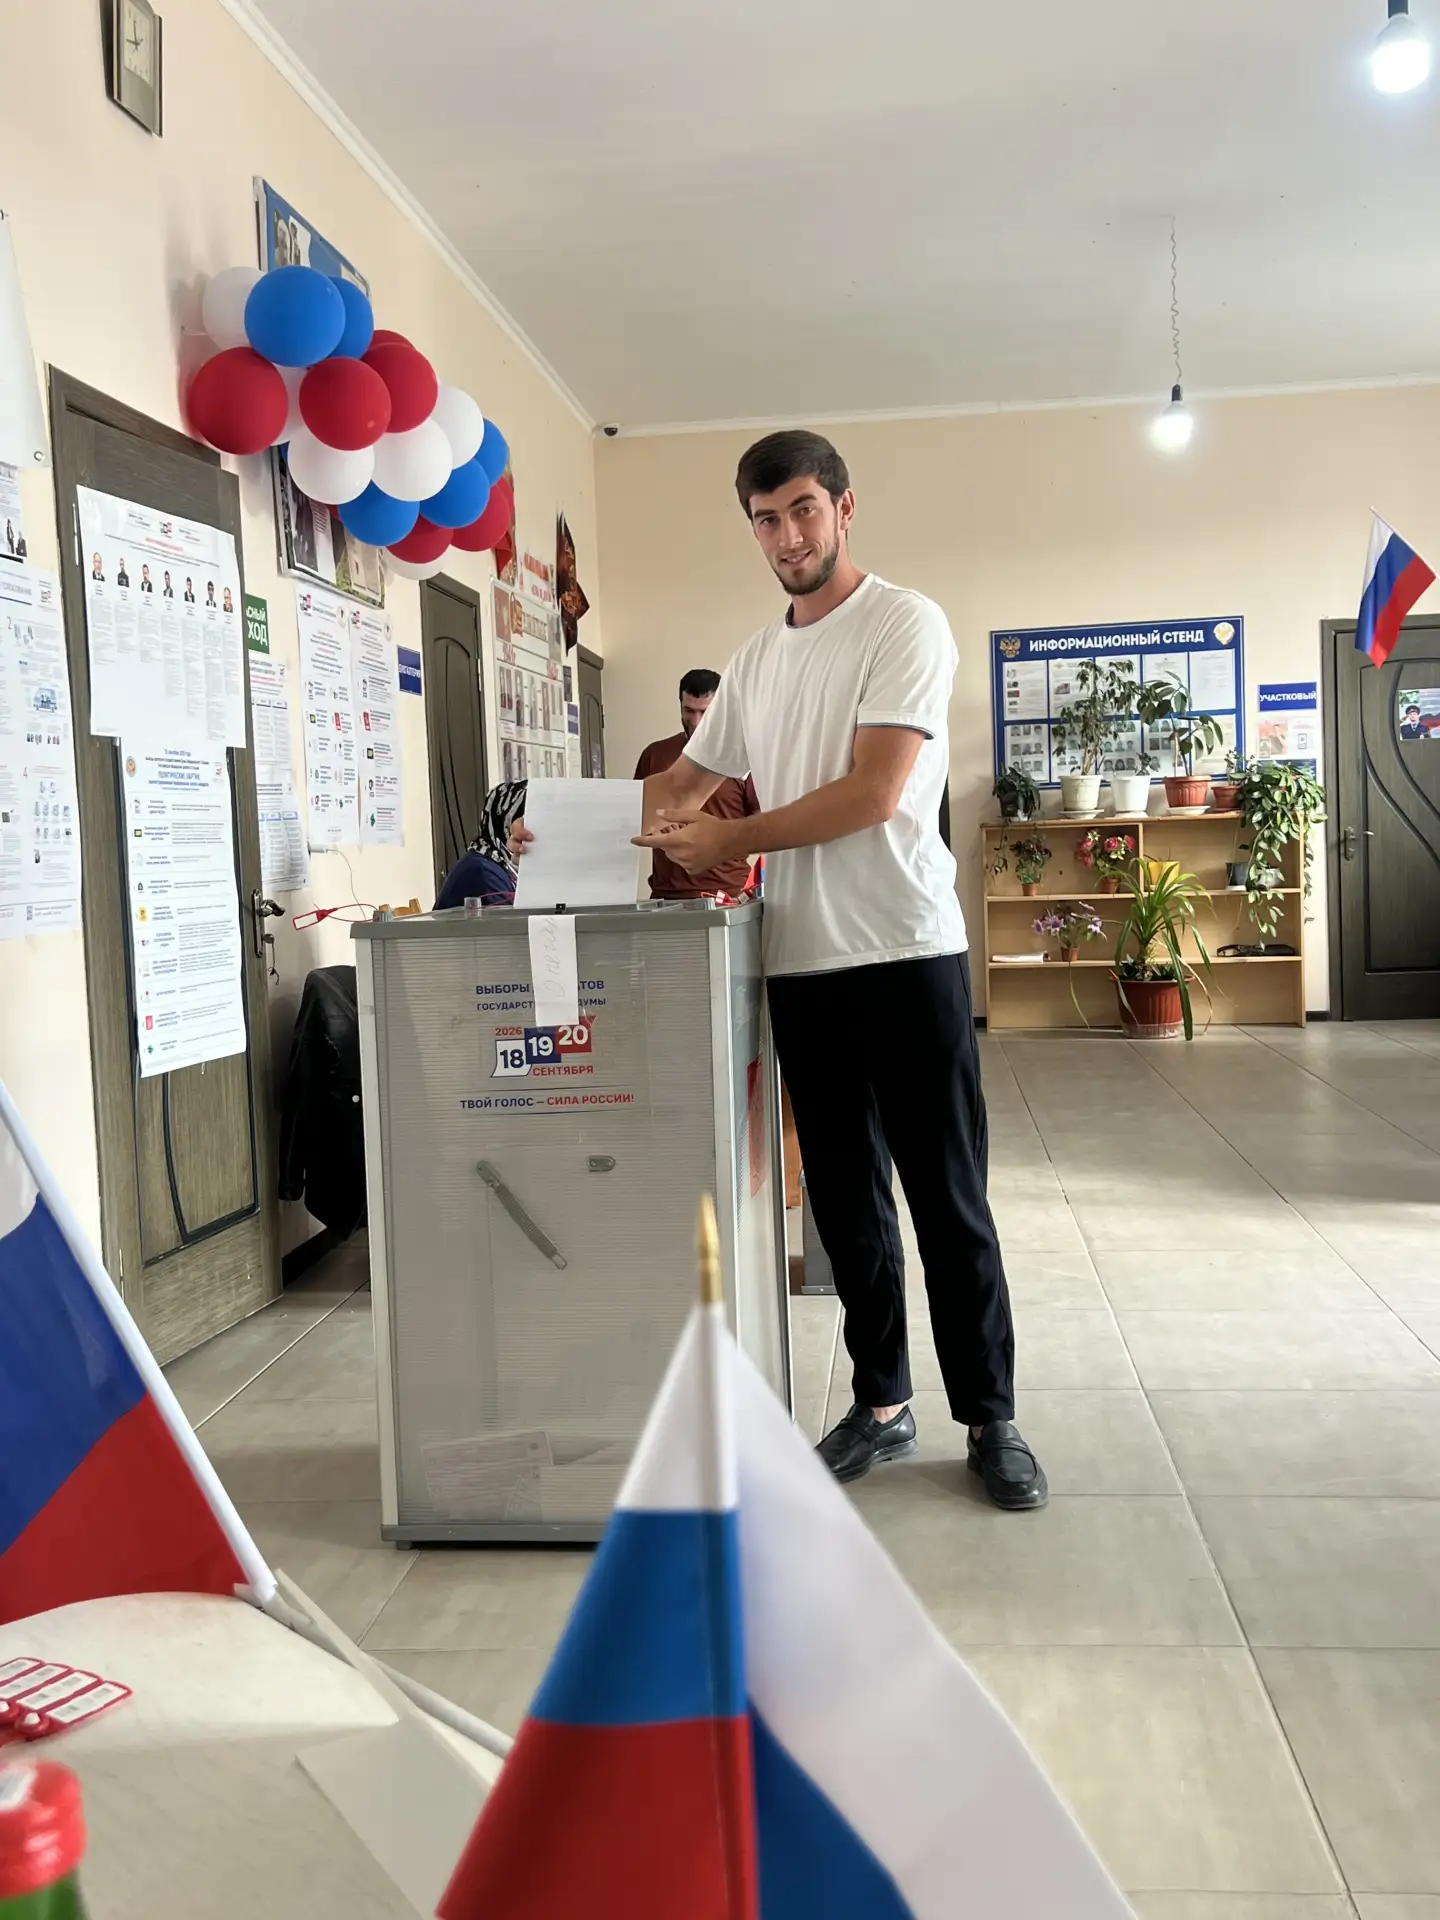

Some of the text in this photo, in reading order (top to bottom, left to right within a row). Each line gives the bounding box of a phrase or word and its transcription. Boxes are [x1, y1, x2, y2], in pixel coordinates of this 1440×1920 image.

[1029, 630, 1204, 652] ИНФОРМАЦИОННЫЙ СТЕНД
[1259, 691, 1317, 702] УЧАСТКОВЫЙ
[476, 984, 529, 995] ВЫБОРЫ
[477, 1001, 536, 1011] ГОСУДАРСТ
[495, 1027, 523, 1036] 2026
[499, 1025, 589, 1069] 18 19 20
[532, 1065, 594, 1077] СЕНТЯБРЯ
[460, 1097, 492, 1109] ТВОЙ
[495, 1098, 534, 1108] ГОЛОС
[547, 1096, 580, 1106] СИЛА
[582, 1094, 635, 1105] РОССИИ!
